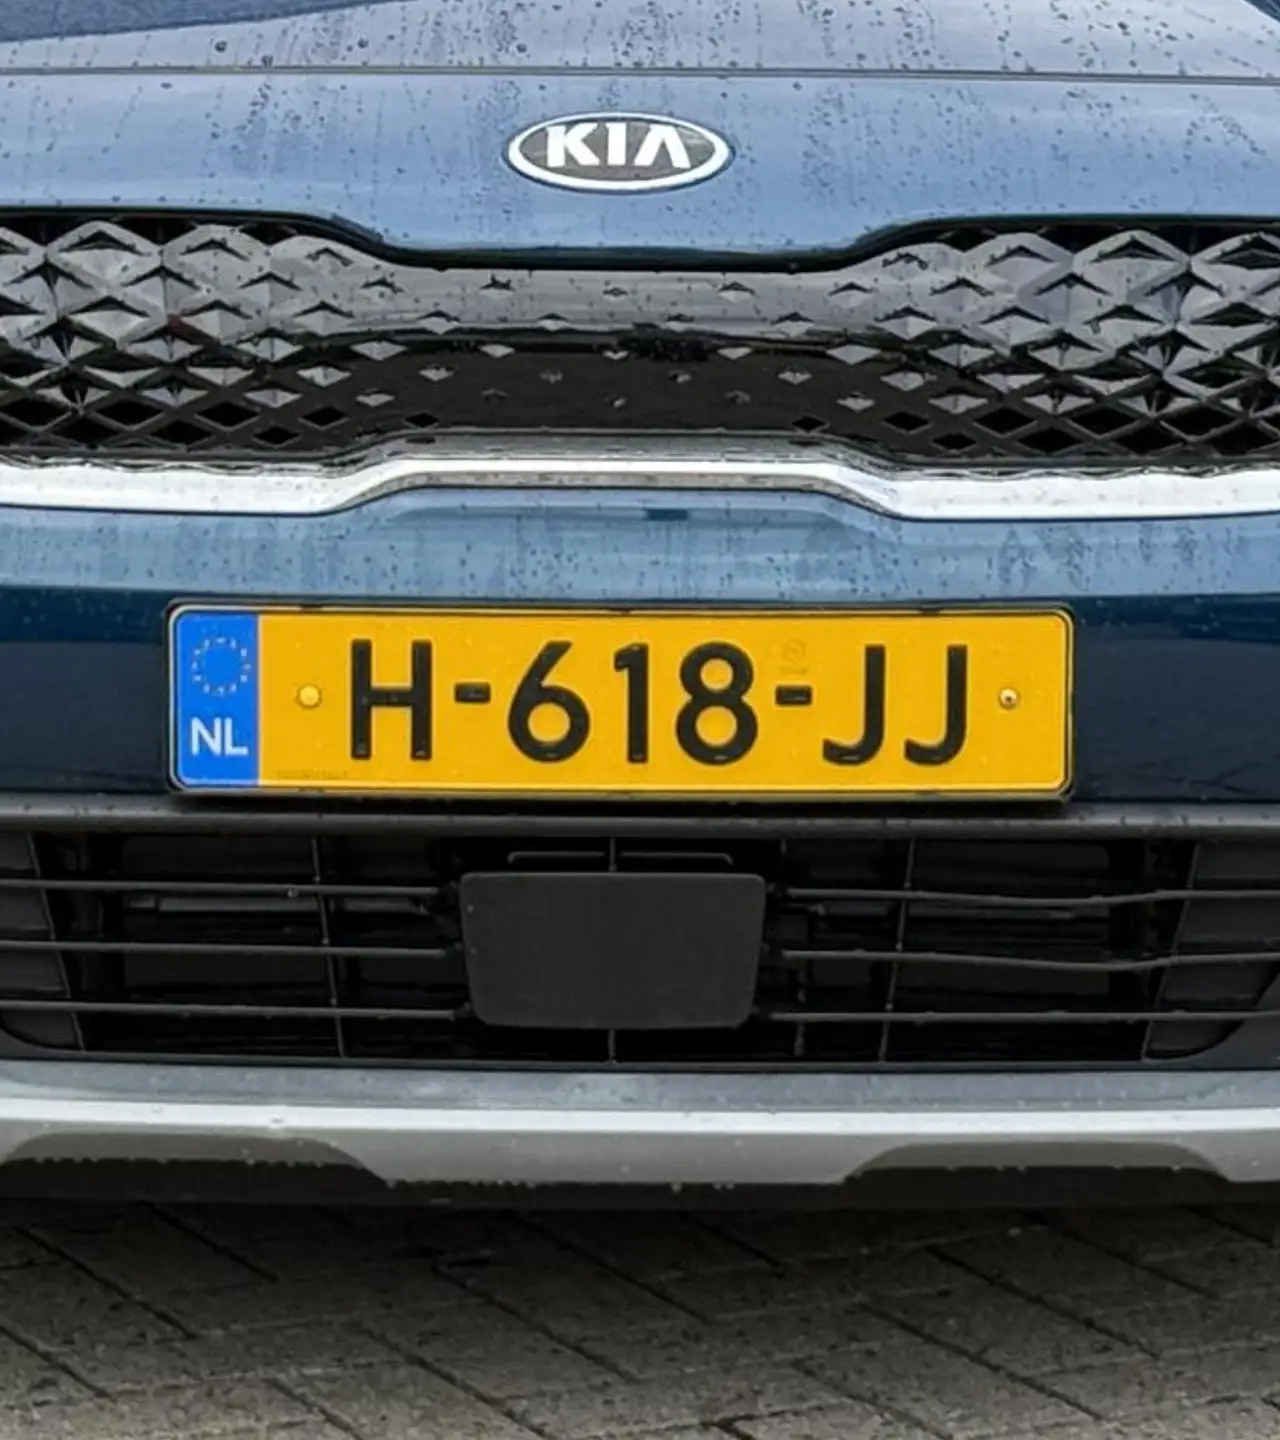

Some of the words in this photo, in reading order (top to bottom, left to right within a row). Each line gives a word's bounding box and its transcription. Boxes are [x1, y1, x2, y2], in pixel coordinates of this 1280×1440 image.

[545, 121, 692, 168] KIA
[350, 639, 969, 766] H-618-JJ
[190, 716, 249, 757] NL
